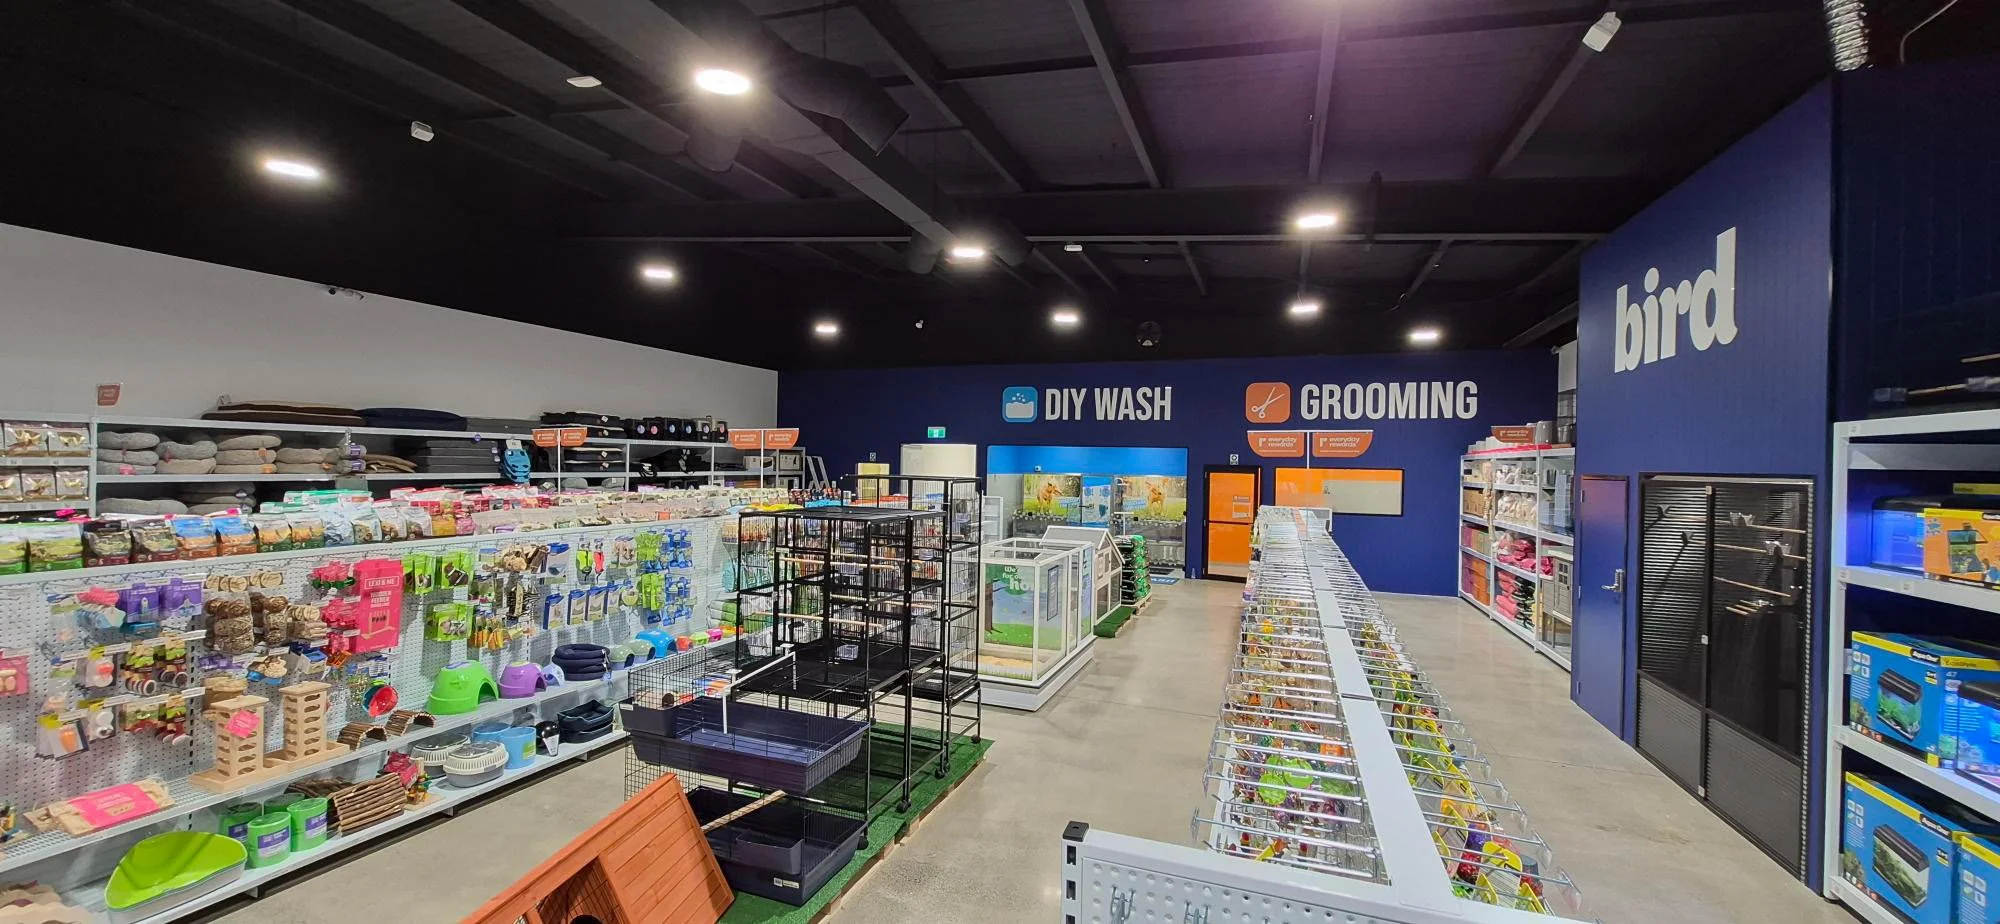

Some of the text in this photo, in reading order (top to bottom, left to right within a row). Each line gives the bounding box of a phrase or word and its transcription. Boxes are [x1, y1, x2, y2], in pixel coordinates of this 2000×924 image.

[1615, 227, 1739, 373] bird
[1045, 386, 1172, 421] DIY WASH
[1300, 381, 1478, 420] GROOMING
